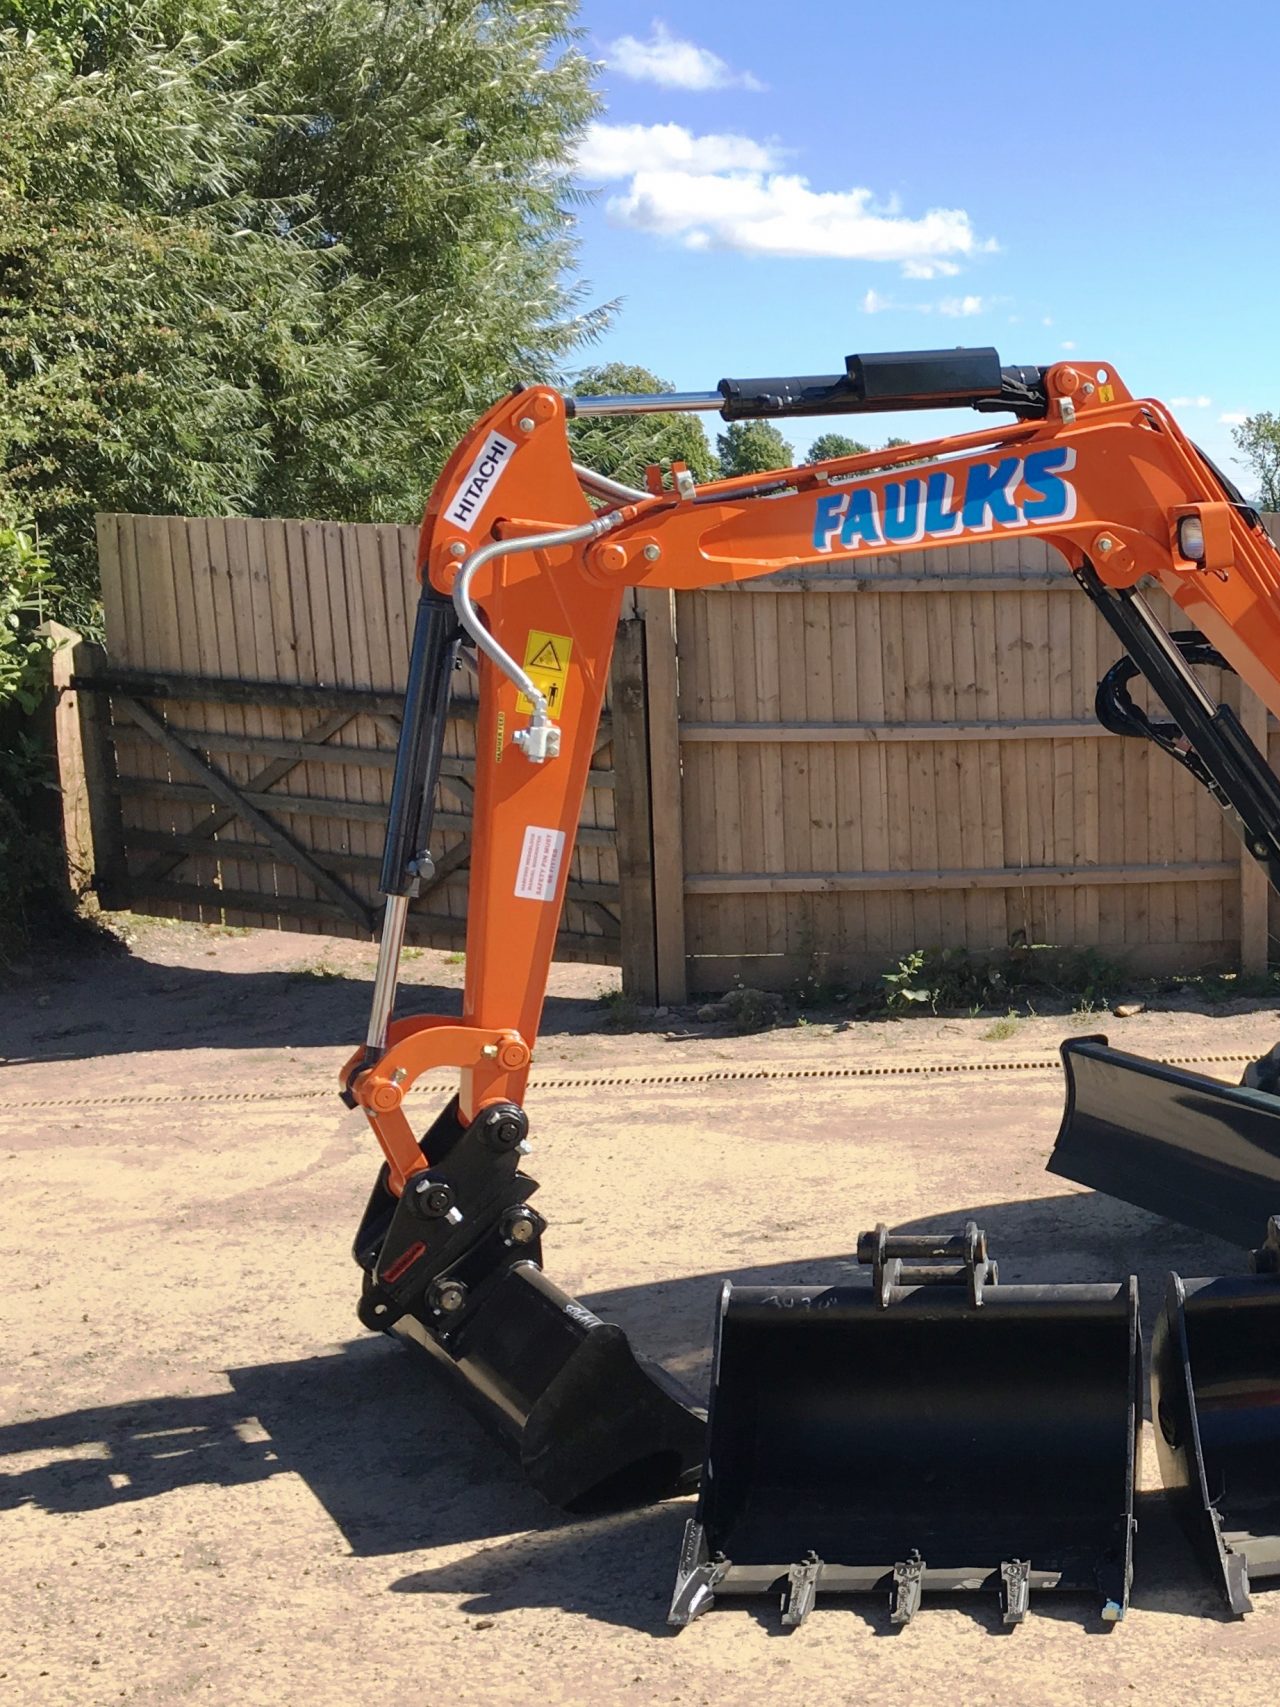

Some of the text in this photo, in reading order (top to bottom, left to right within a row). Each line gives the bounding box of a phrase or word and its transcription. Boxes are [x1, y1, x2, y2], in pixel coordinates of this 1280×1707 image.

[453, 439, 509, 523] HITACHI
[812, 446, 1077, 554] FAULKS
[535, 834, 553, 896] SAFETY PIN MUST
[547, 847, 559, 885] BE FITTED
